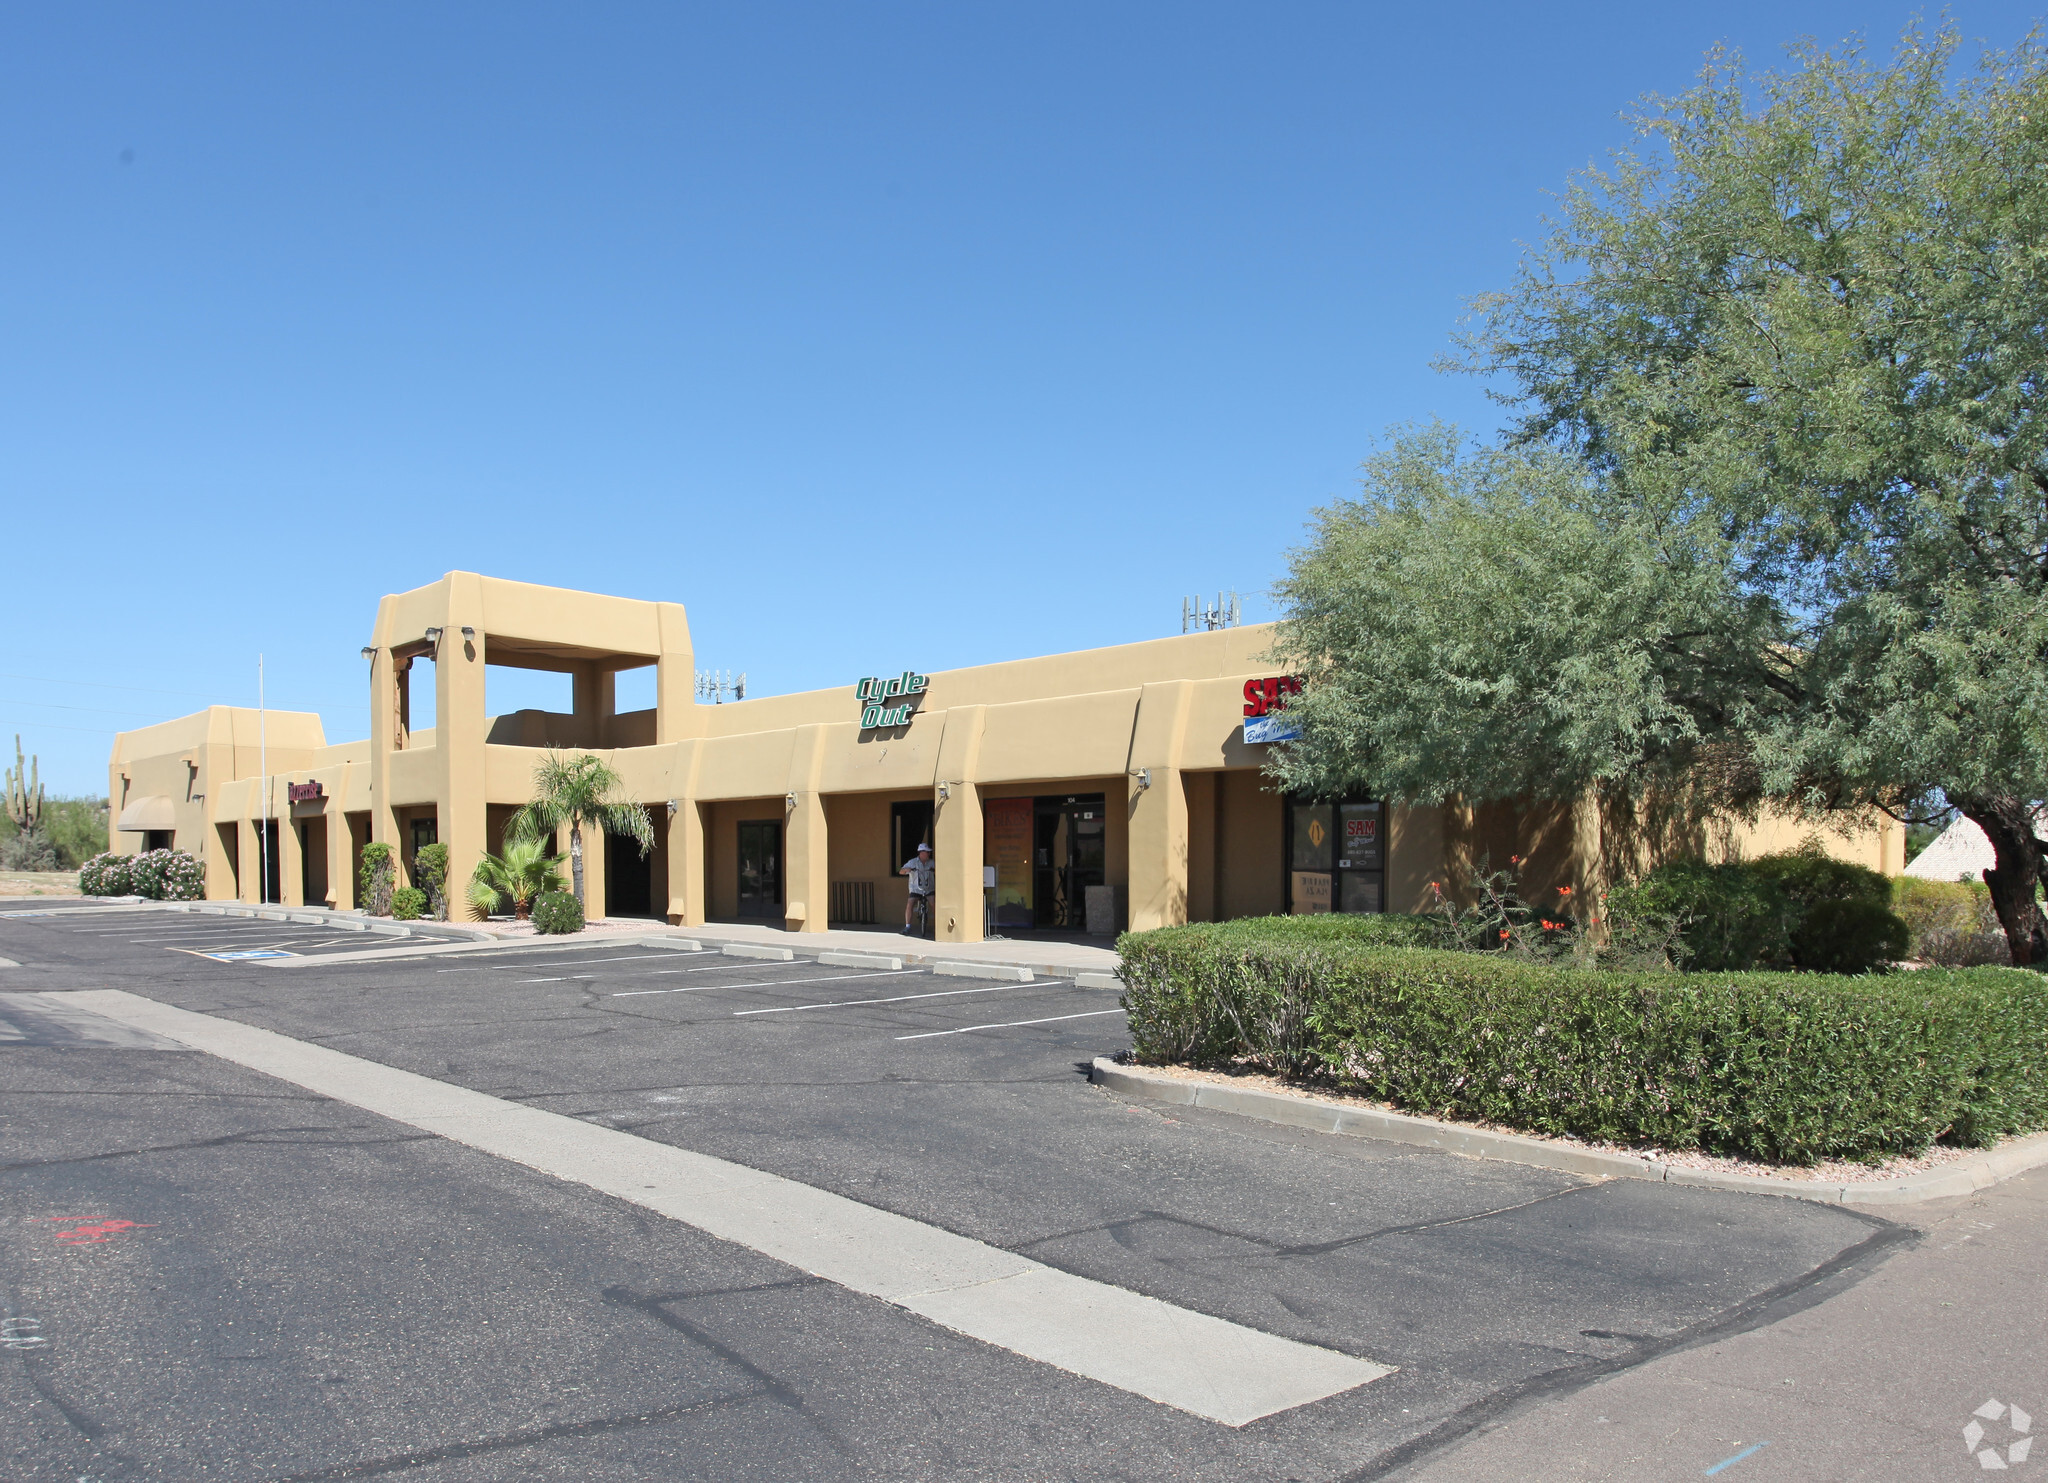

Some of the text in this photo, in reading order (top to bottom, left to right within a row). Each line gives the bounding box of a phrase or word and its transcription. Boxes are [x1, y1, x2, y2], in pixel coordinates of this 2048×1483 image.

[855, 671, 927, 705] Cycle
[860, 704, 912, 729] Out
[1246, 730, 1268, 743] Bug
[1347, 820, 1376, 836] SAM
